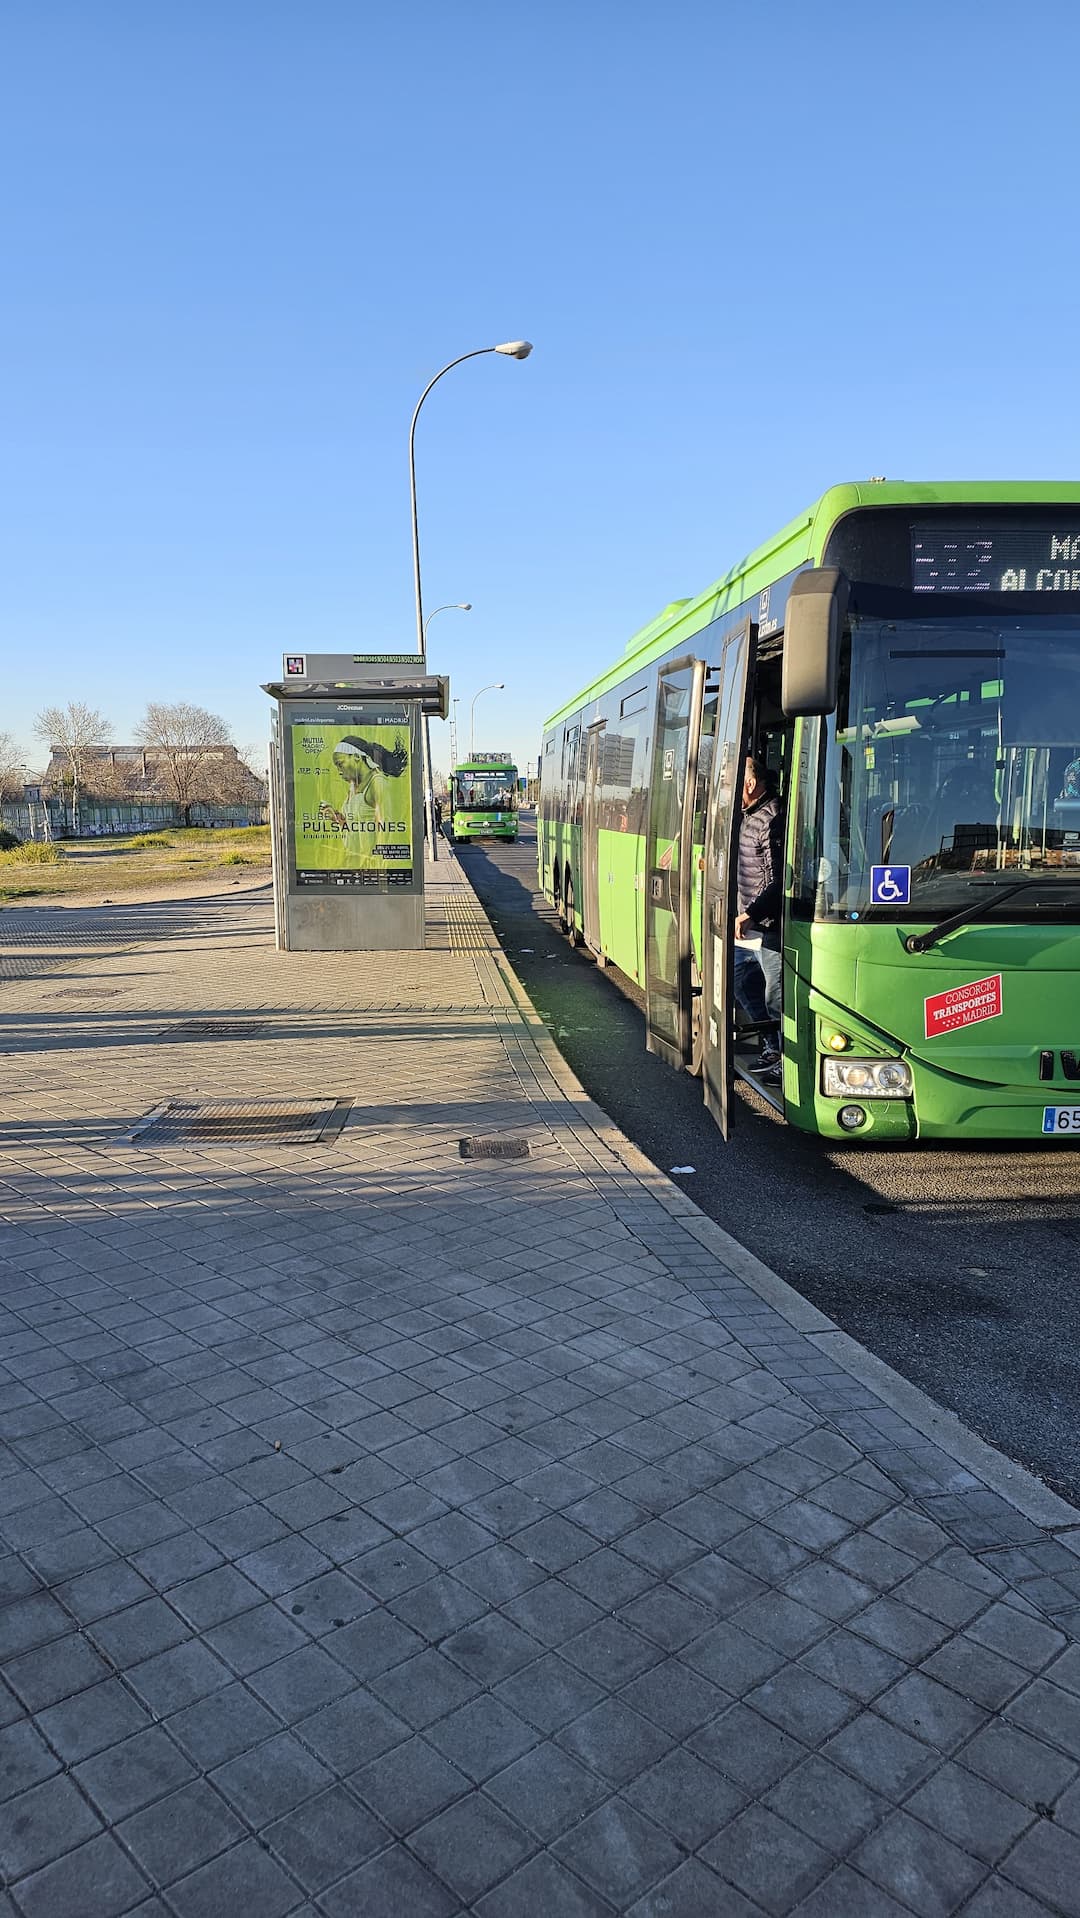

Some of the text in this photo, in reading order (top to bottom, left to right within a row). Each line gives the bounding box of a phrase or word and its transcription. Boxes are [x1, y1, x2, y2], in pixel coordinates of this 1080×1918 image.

[303, 821, 406, 833] PULSACIONES
[945, 979, 996, 1004] CONSORCIO
[933, 992, 996, 1021] TRANSPORTES
[962, 1004, 997, 1023] MADRID
[1058, 1110, 1080, 1129] 65
